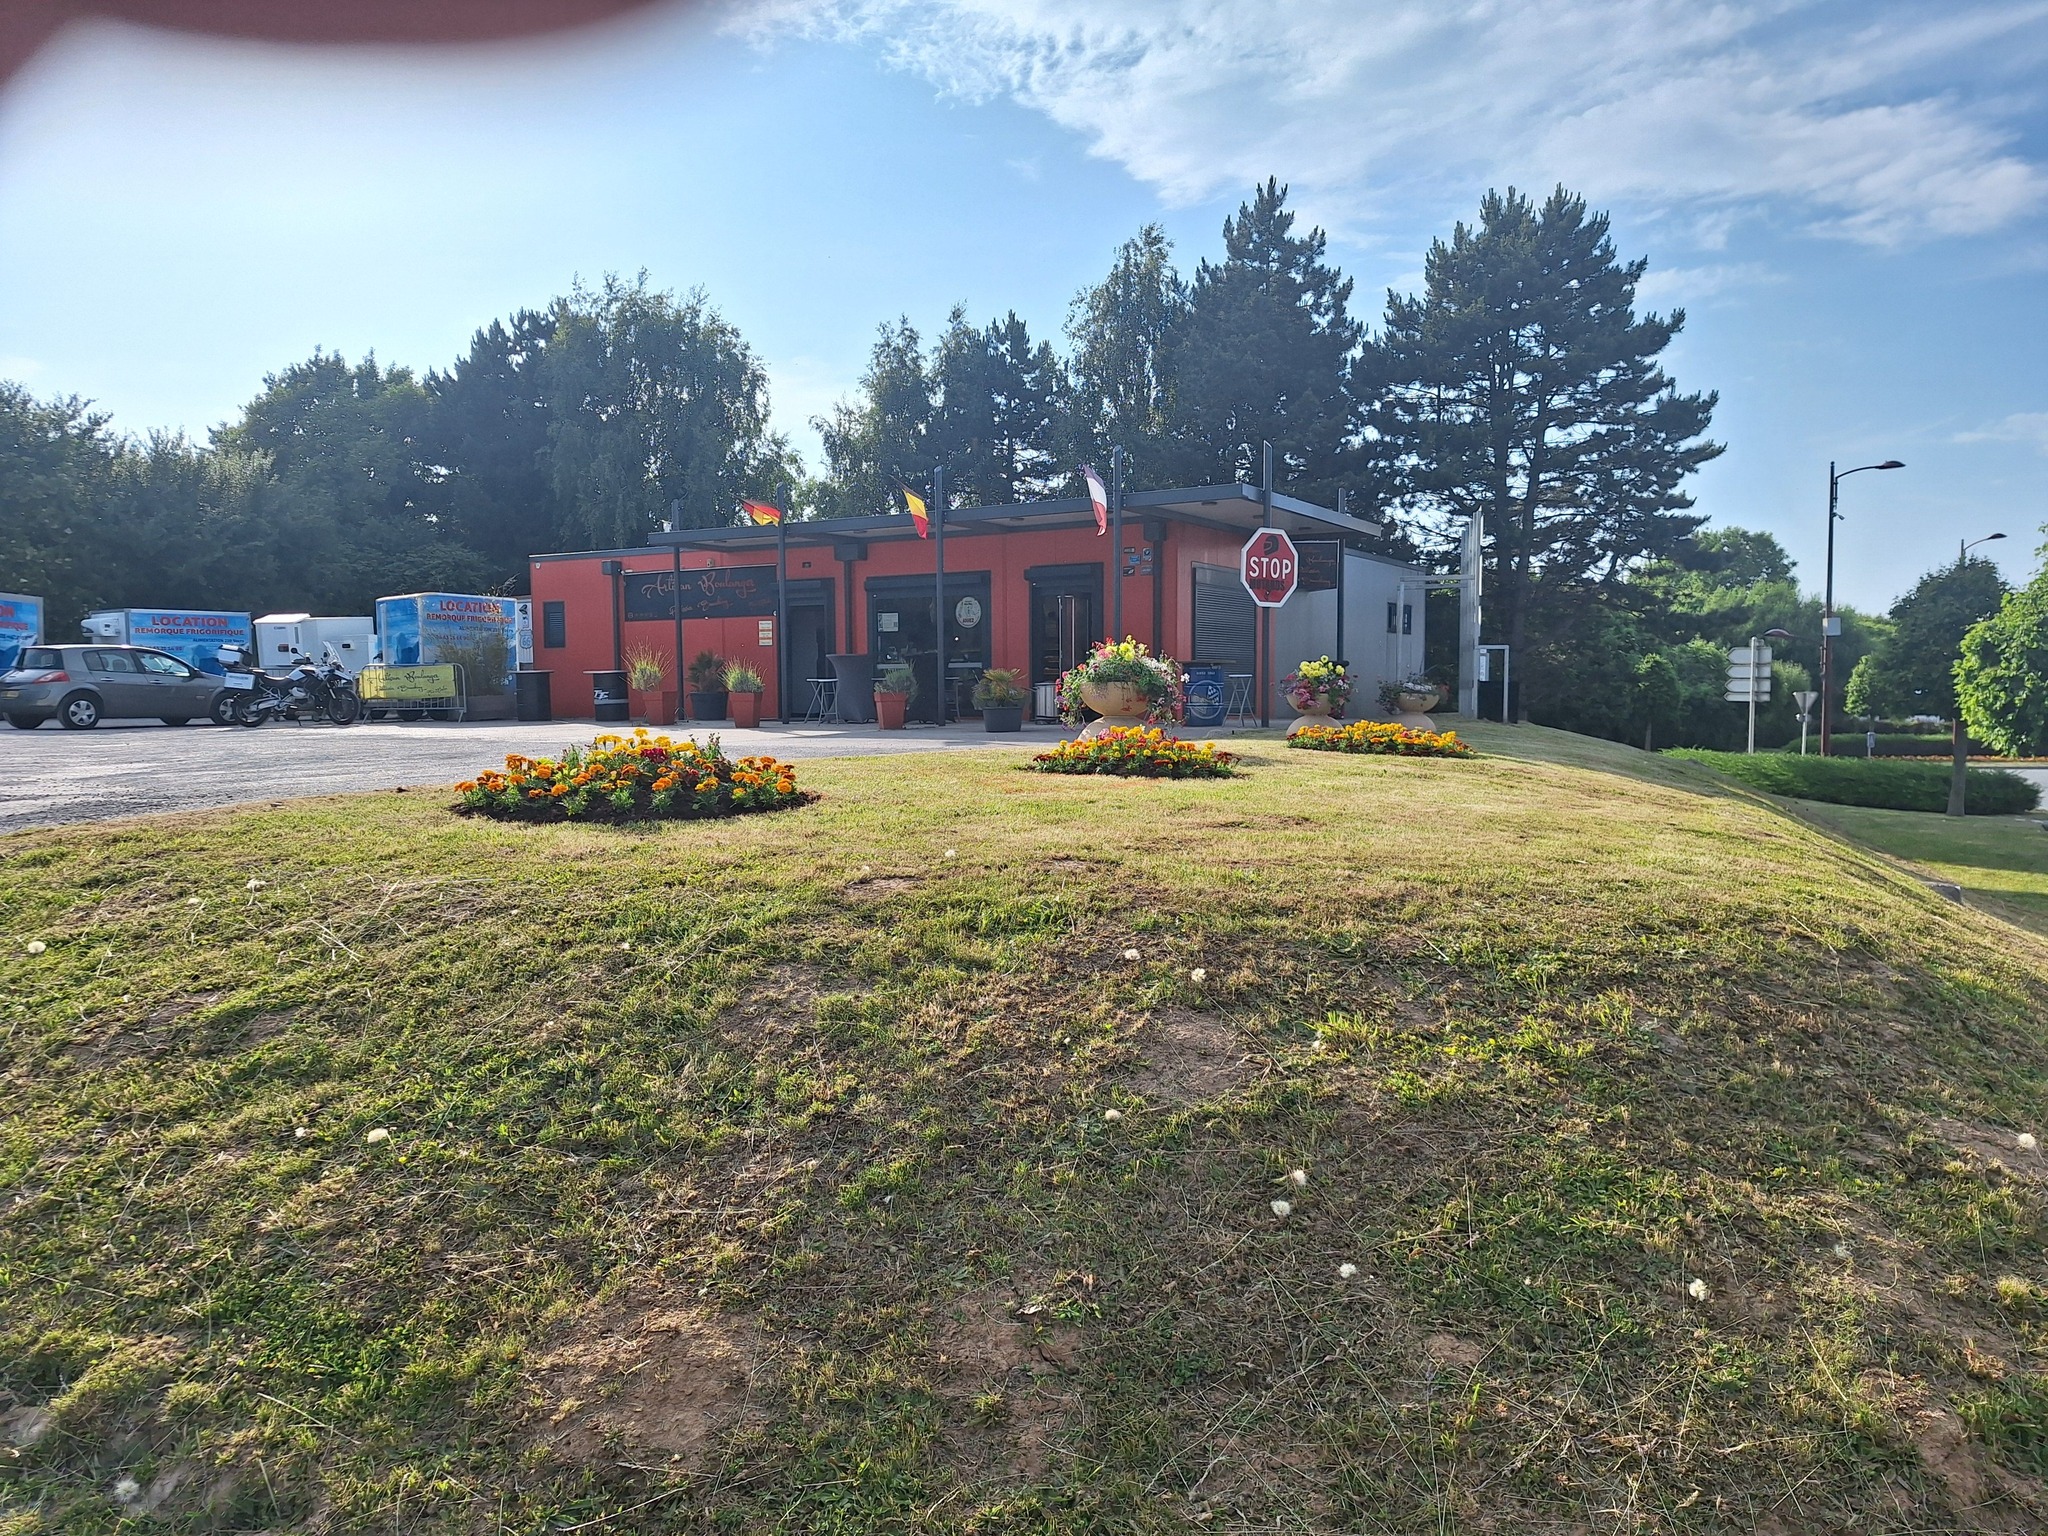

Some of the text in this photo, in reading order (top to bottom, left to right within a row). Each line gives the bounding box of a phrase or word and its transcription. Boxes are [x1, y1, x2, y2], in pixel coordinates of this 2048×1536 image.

[1249, 556, 1292, 580] STOP
[641, 569, 757, 599] Artian Boulanger
[440, 600, 501, 613] LOCATION
[152, 616, 229, 627] LOCATION
[427, 613, 465, 623] REMORQUE
[135, 627, 244, 636] REMORQUE FRIGORIFIQUE
